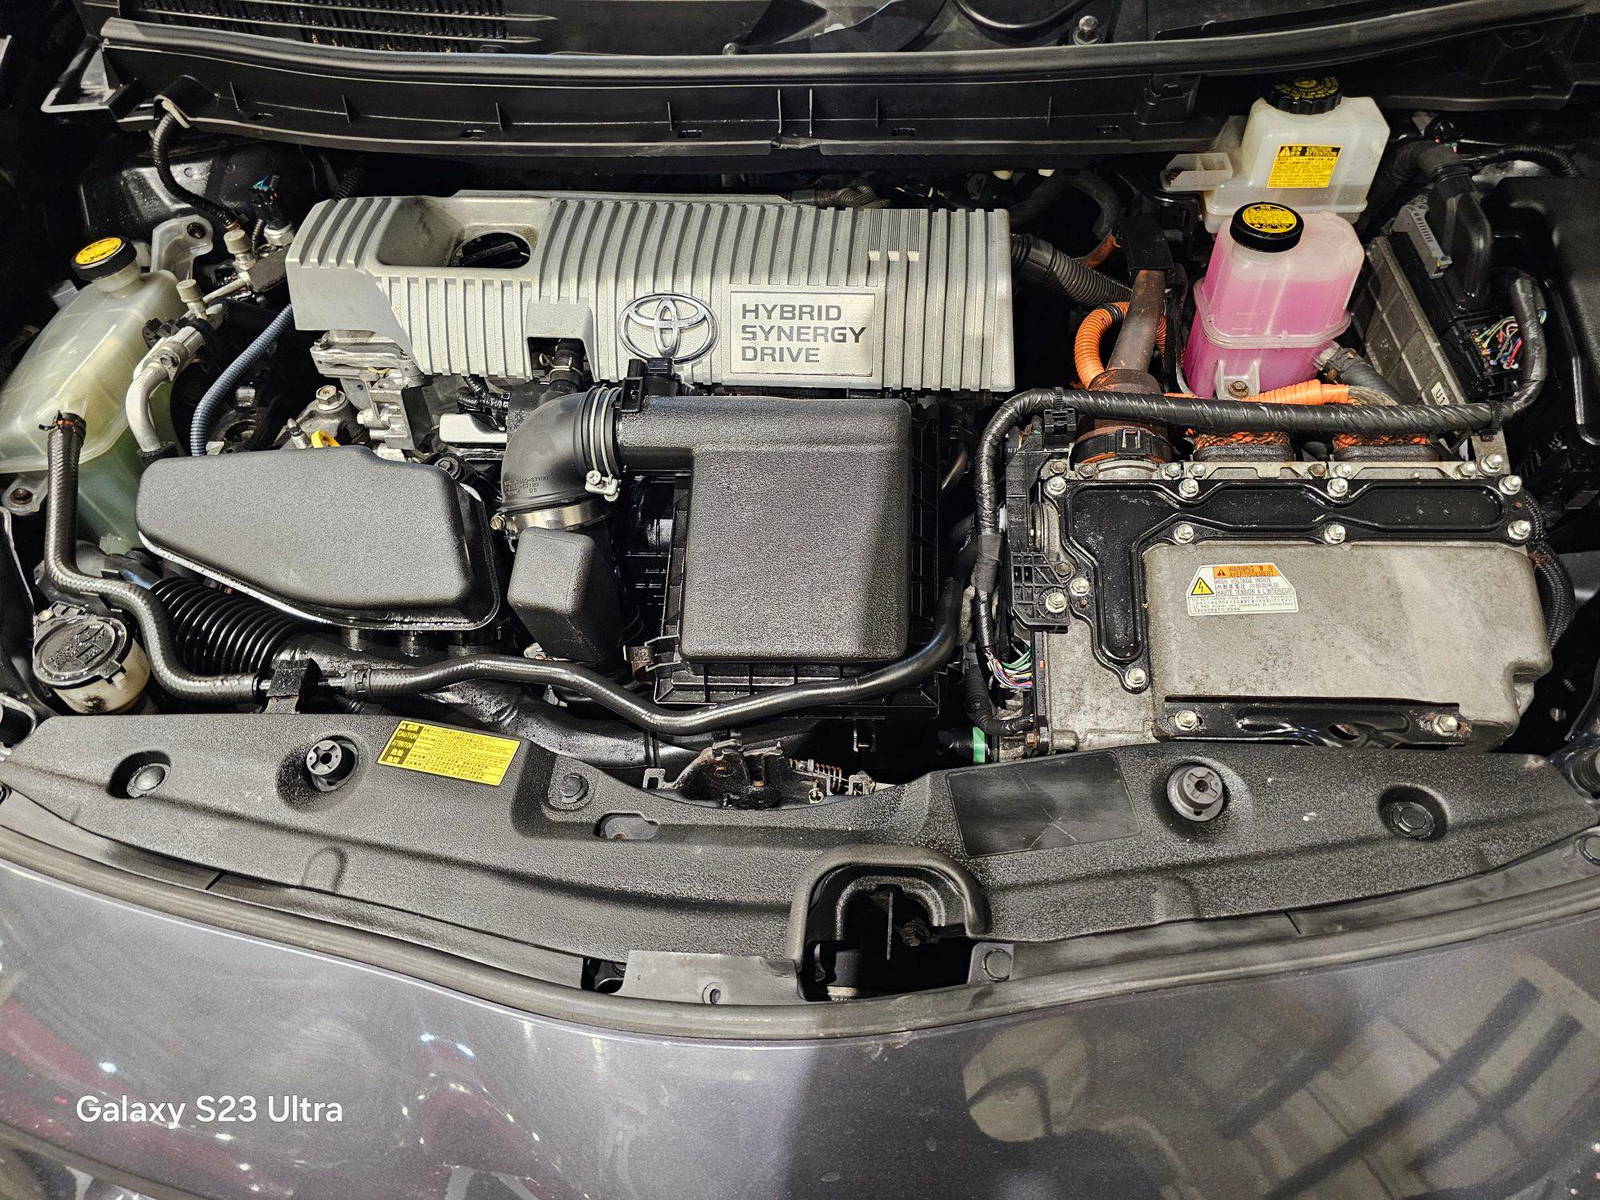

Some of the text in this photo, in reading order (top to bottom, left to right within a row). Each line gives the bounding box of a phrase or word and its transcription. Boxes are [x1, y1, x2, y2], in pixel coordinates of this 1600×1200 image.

[741, 303, 842, 321] HYBRID
[741, 324, 866, 343] SYNERGY
[741, 346, 820, 363] DRIVE
